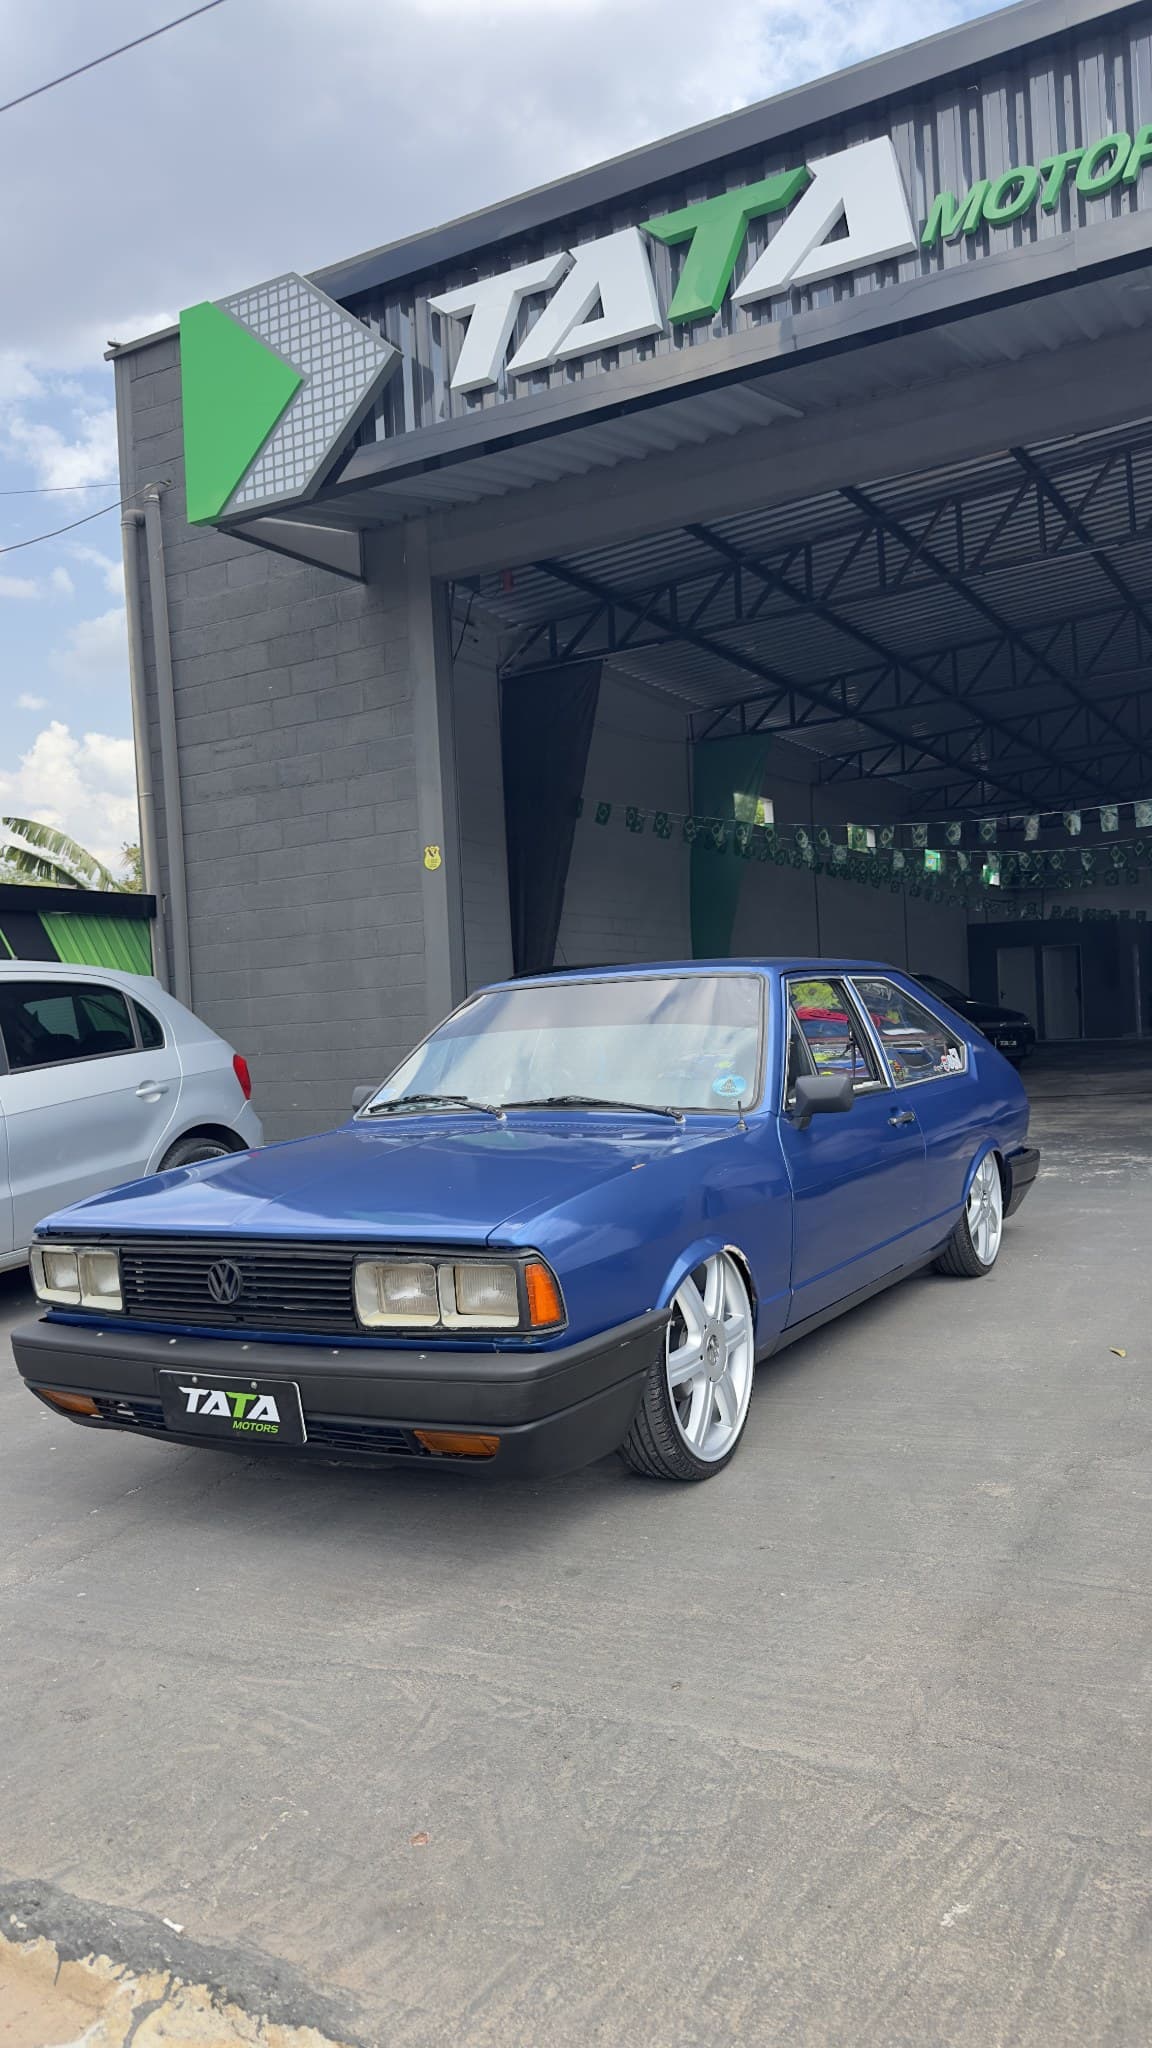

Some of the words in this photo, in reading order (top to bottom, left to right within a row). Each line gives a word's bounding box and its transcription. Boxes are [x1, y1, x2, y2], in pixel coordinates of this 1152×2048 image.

[428, 136, 917, 393] TATA
[178, 1386, 280, 1422] TATA
[233, 1421, 279, 1433] MOTORS
